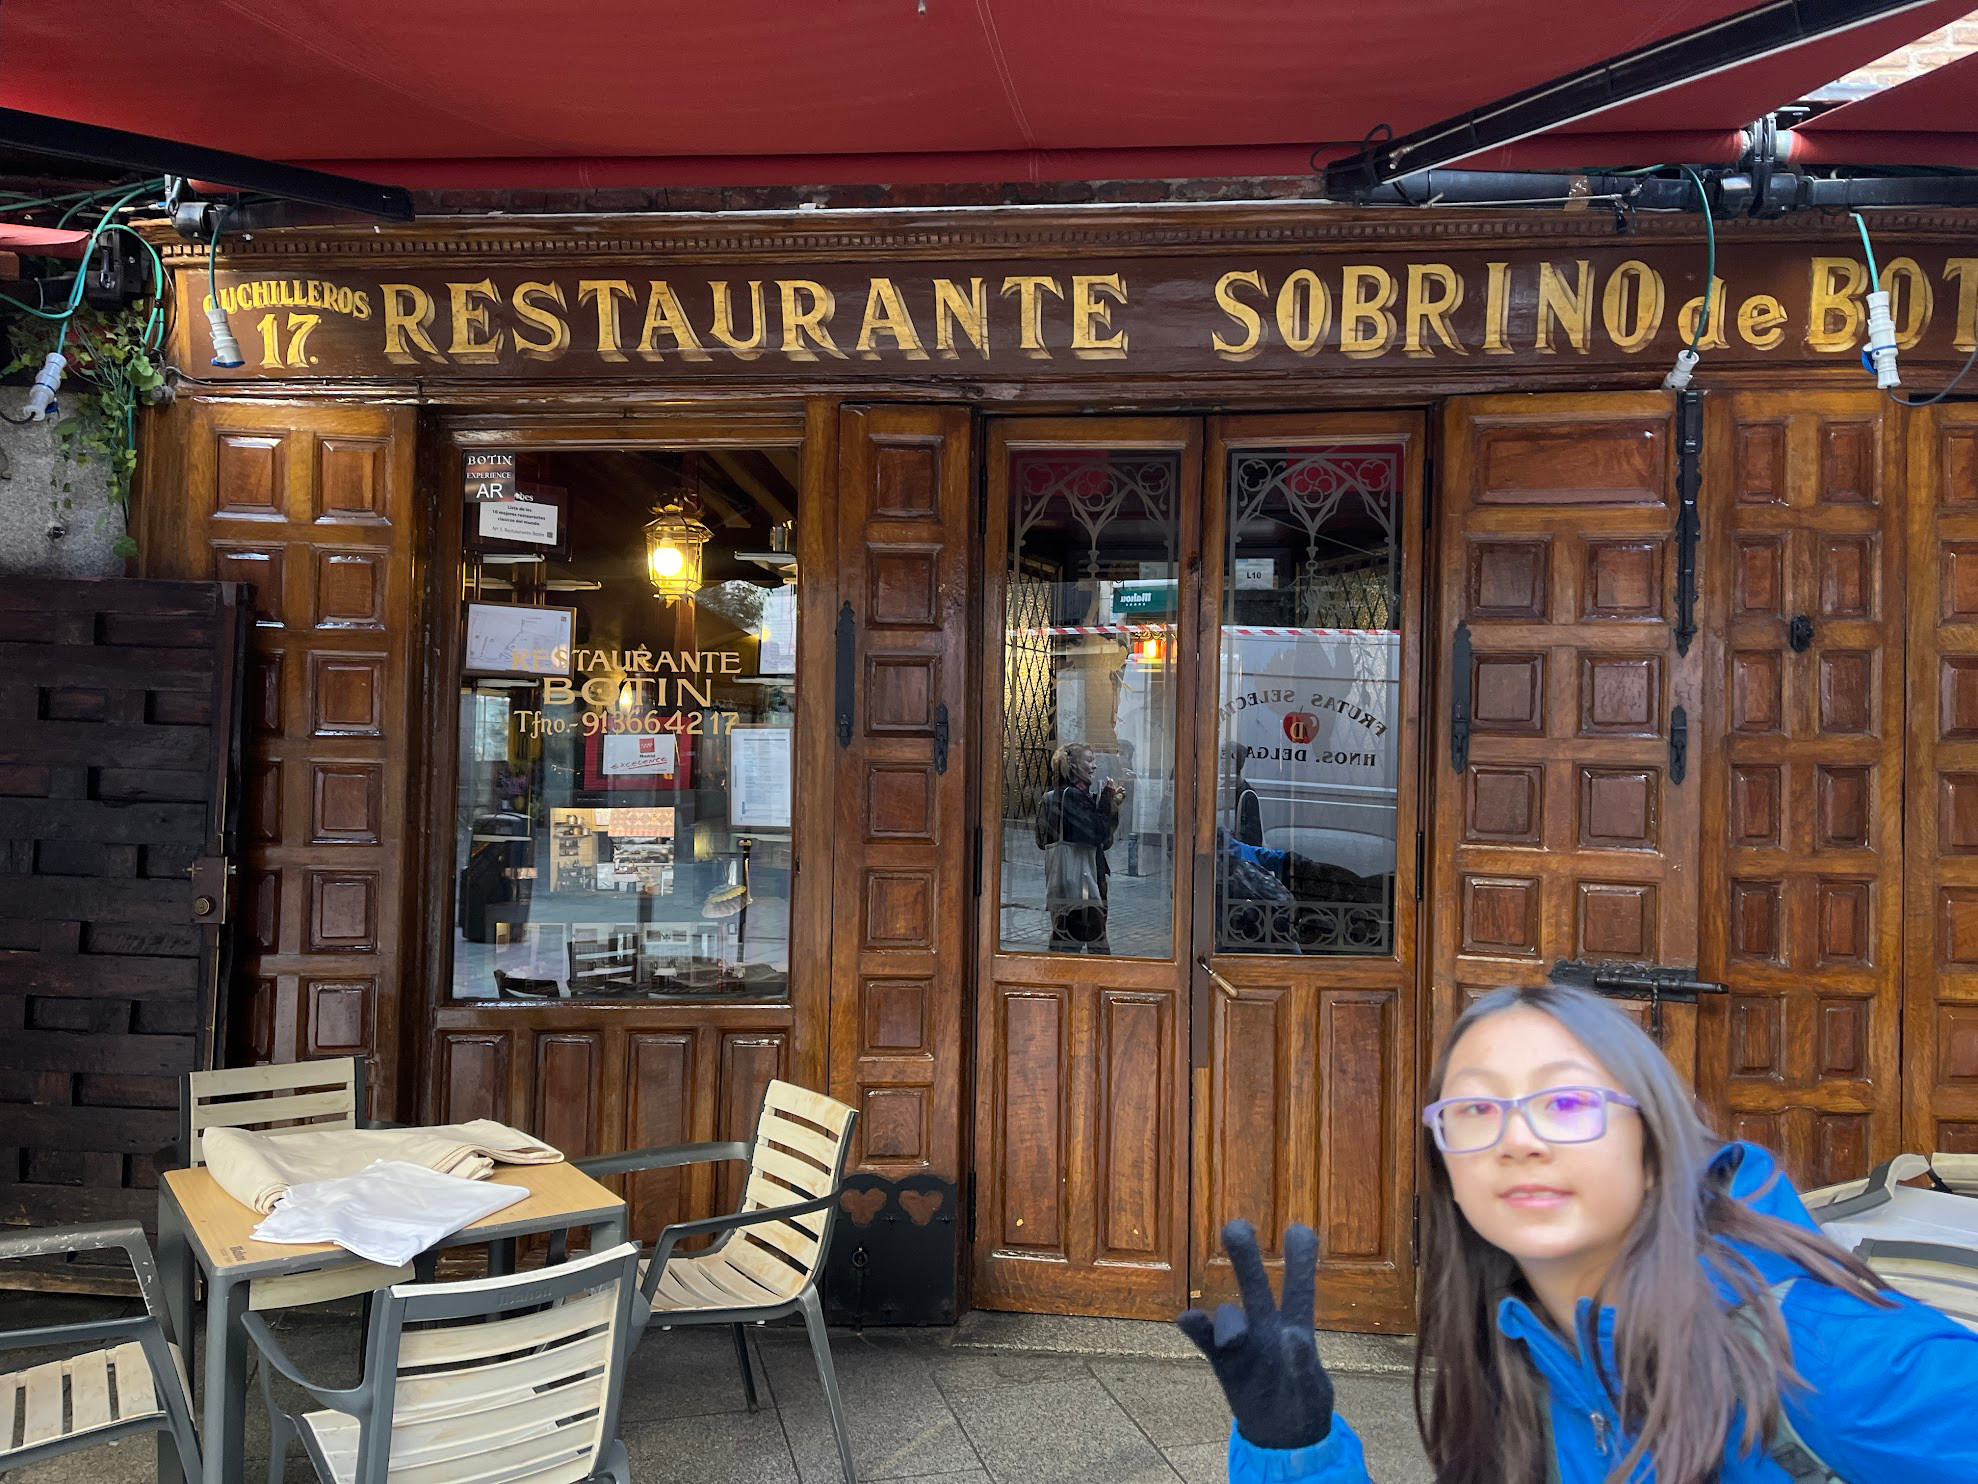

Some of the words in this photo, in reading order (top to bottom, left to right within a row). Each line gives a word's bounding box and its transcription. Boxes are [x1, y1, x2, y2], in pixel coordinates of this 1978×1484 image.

[379, 273, 1128, 364] RESTAURANTE
[1212, 259, 1665, 362] SOBRINO
[1678, 275, 1788, 351] de
[476, 483, 503, 498] AR
[1247, 571, 1261, 579] L10
[512, 650, 742, 674] RESTAURANTE
[543, 677, 712, 707] BOTIN
